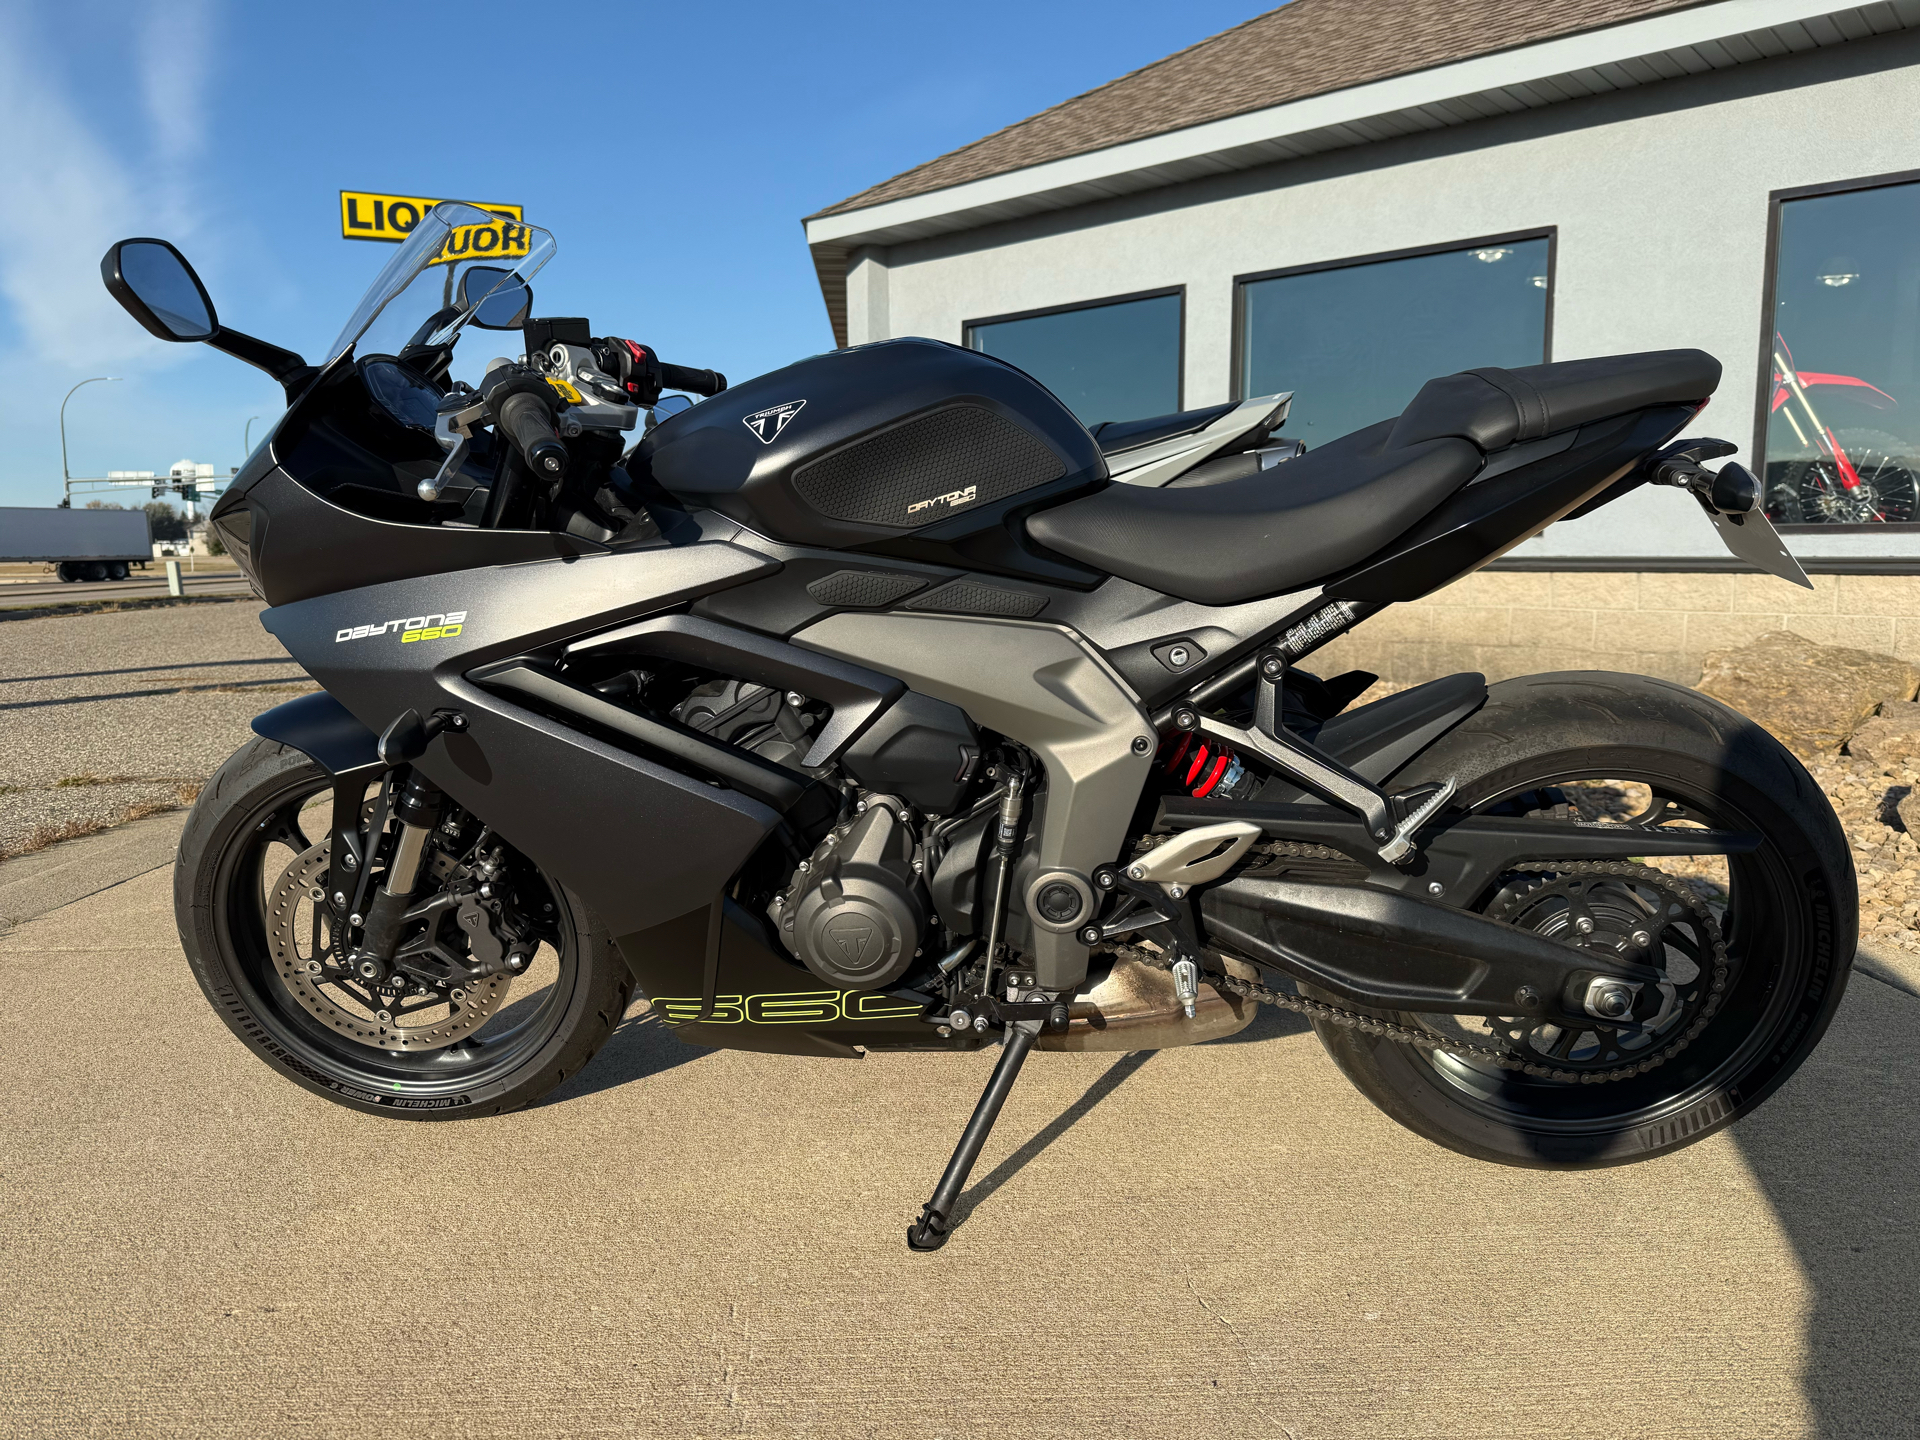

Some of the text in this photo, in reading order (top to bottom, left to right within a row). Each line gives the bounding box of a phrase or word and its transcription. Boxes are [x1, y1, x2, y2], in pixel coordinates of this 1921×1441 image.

[755, 404, 792, 419] TRIUMPH
[907, 485, 977, 514] DAYTONA
[401, 624, 463, 643] 660
[1808, 903, 1831, 1000] MICHELIN
[1780, 1012, 1809, 1054] POWER
[341, 1085, 382, 1103] POWER
[392, 1098, 451, 1108] MICHELIN
